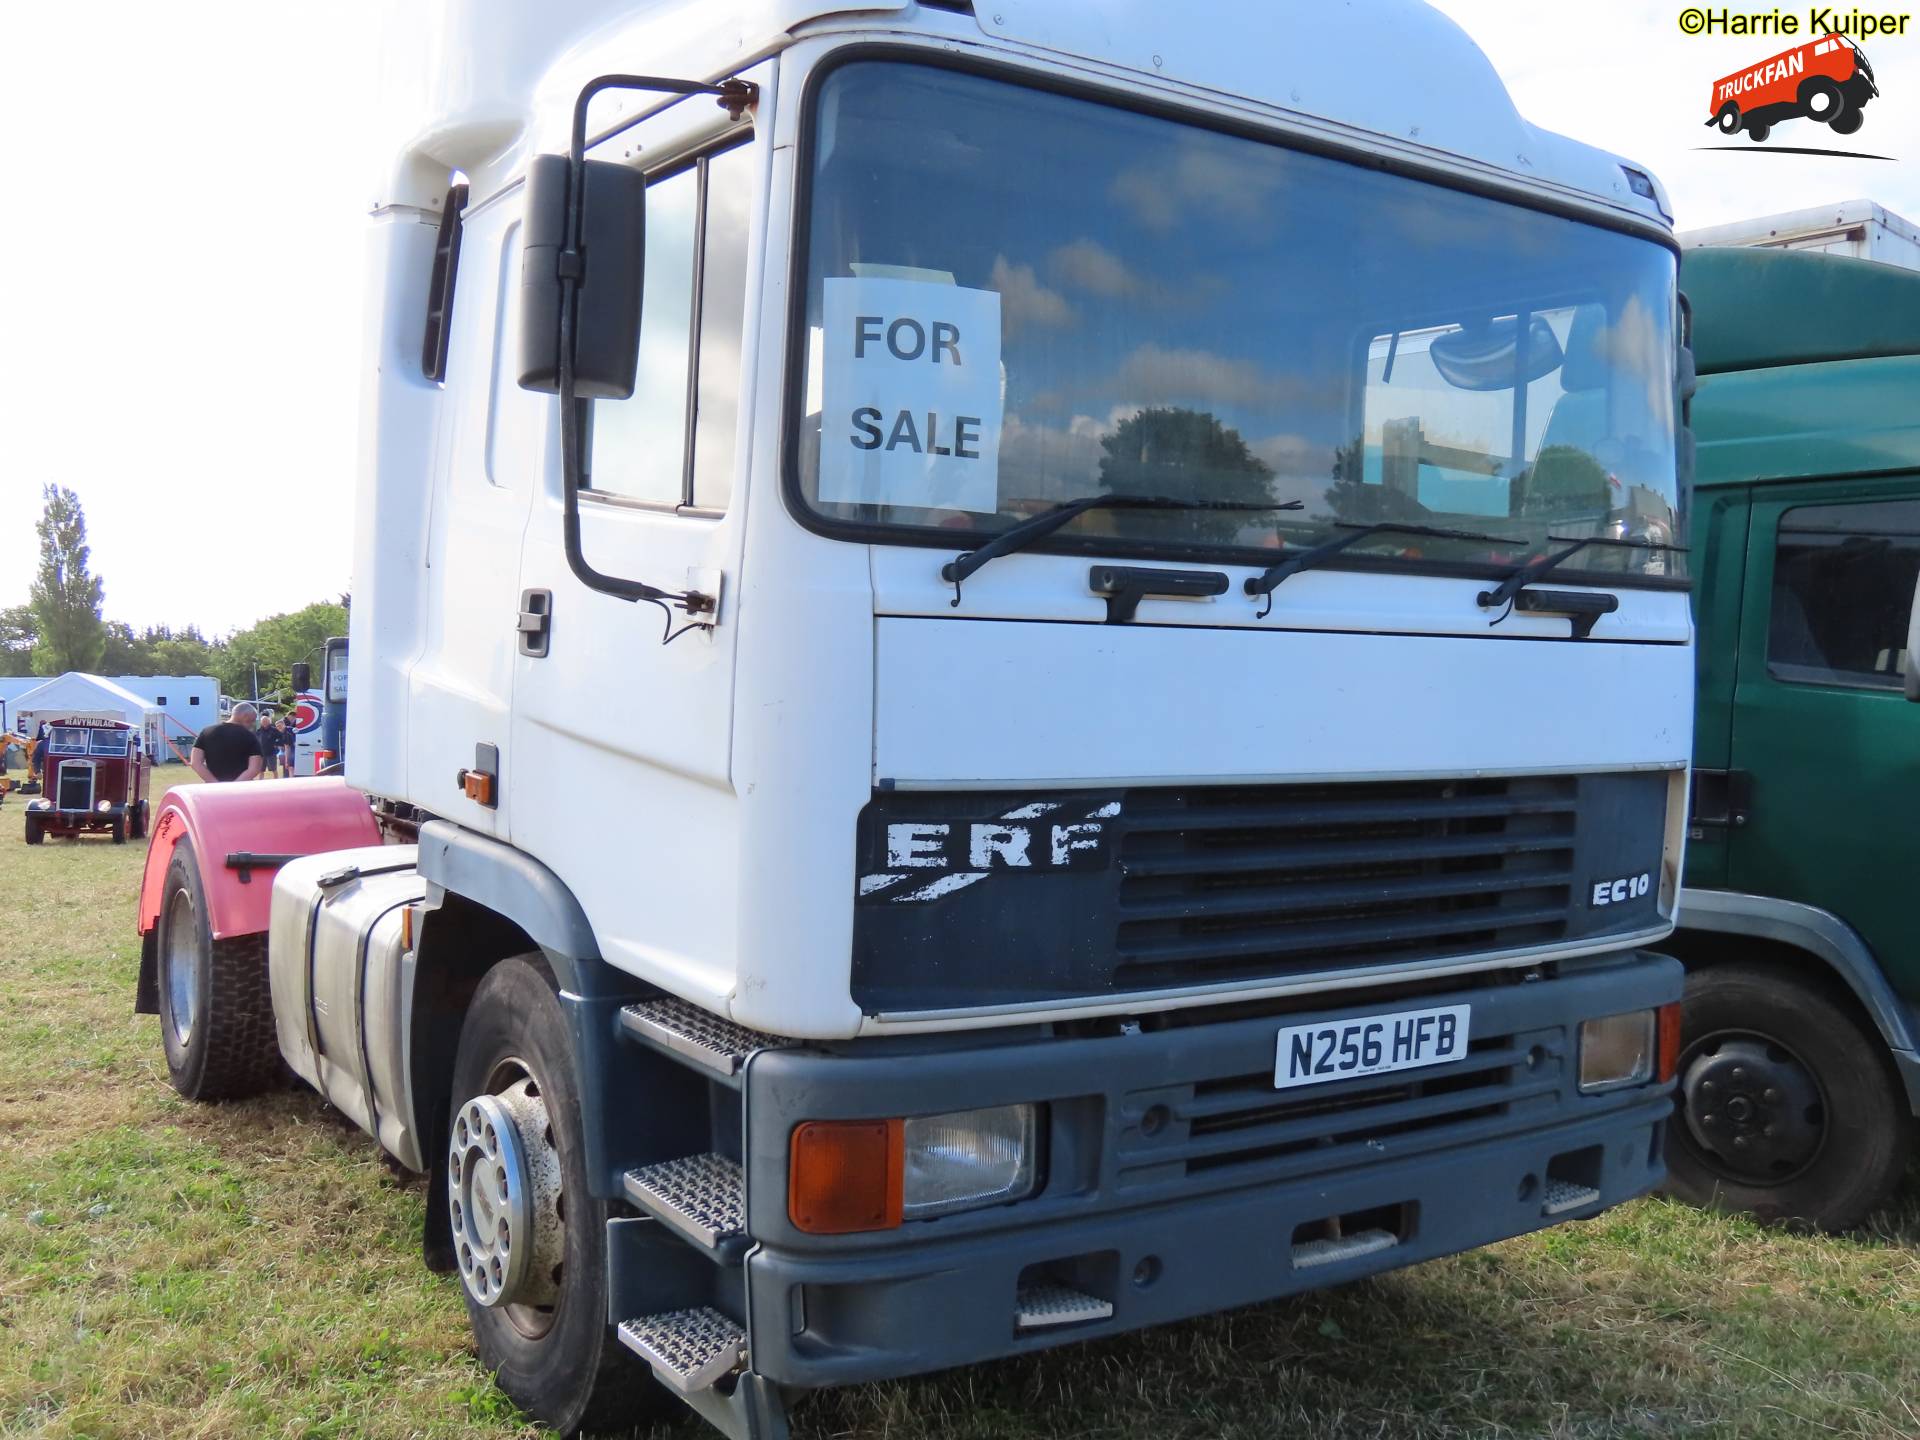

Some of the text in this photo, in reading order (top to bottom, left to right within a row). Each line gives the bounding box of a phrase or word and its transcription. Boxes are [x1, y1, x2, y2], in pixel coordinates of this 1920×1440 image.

[854, 316, 962, 366] FOR
[850, 407, 982, 459] SALE
[887, 822, 1102, 869] ERF
[1592, 873, 1649, 906] EC10
[1289, 1013, 1457, 1079] N256 HFB
